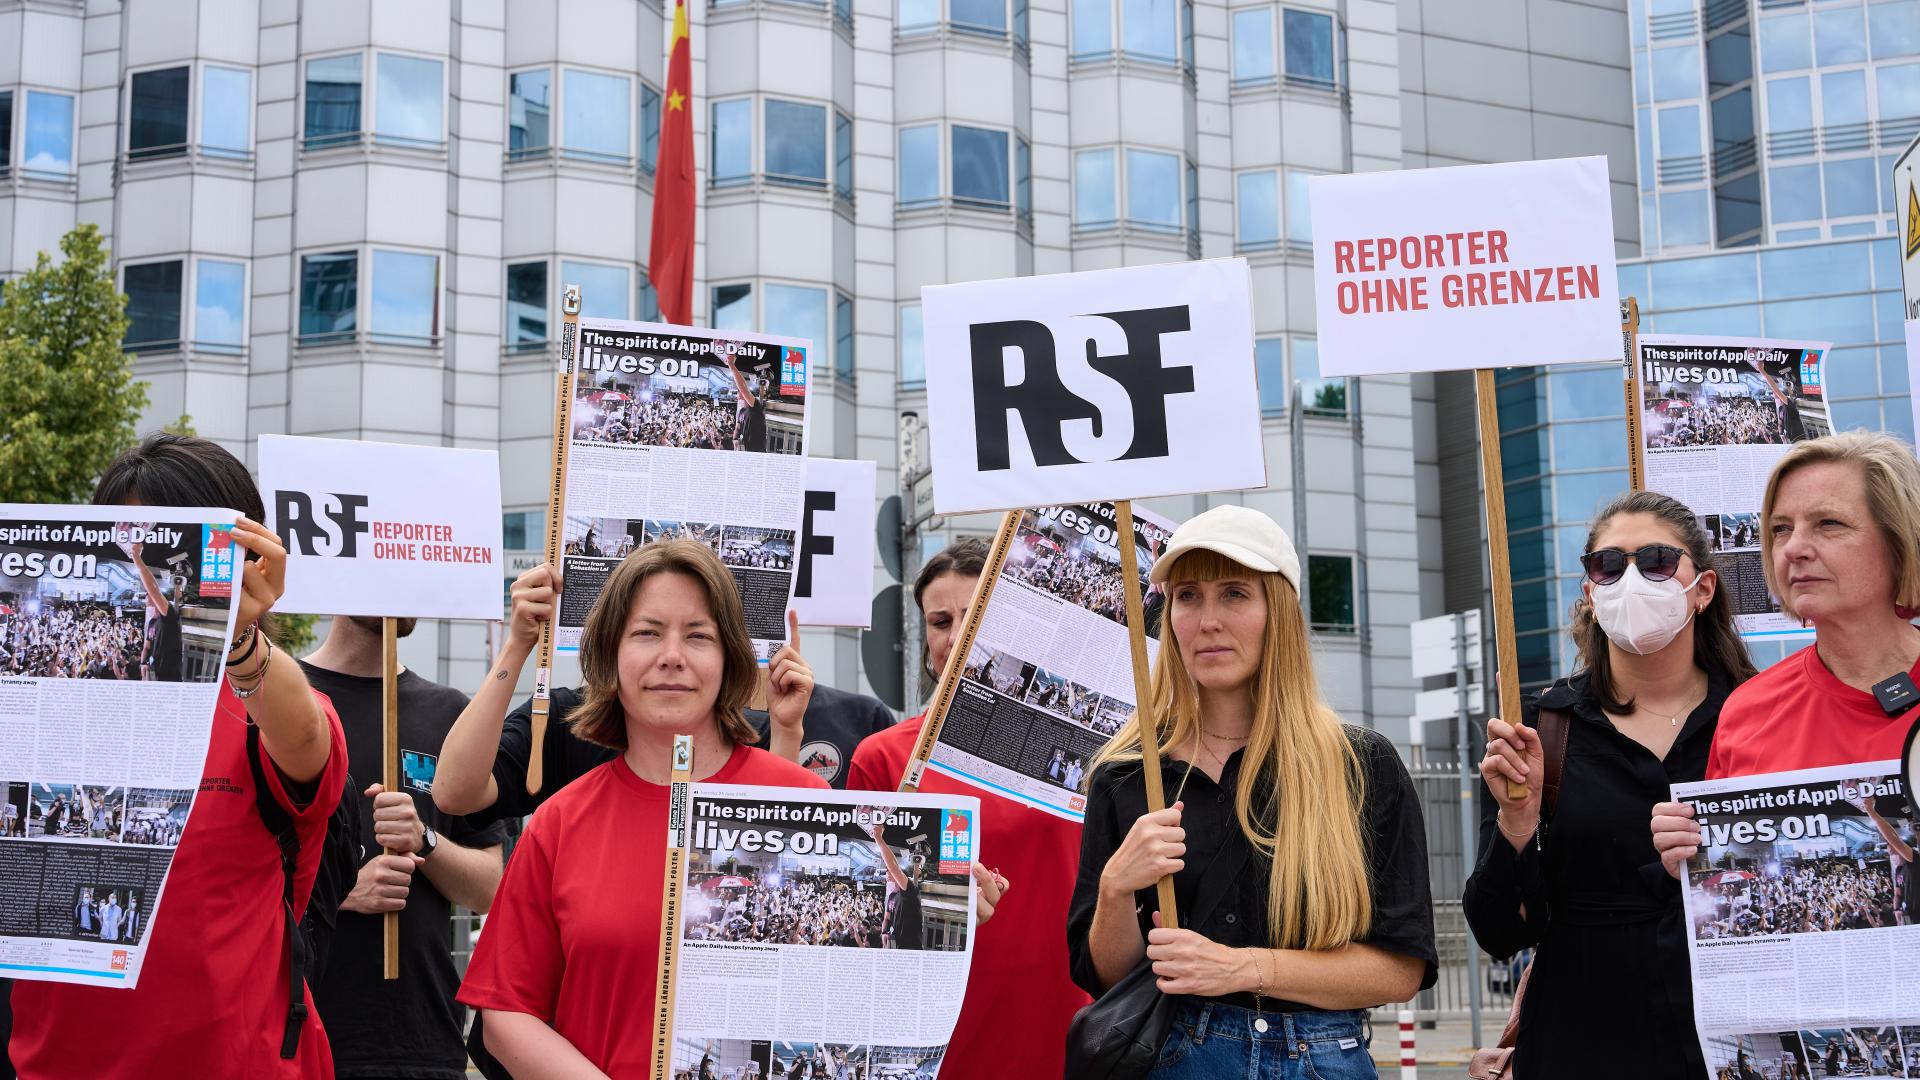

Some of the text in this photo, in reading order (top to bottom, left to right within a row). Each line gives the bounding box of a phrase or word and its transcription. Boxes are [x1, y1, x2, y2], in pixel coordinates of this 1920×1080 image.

[1334, 230, 1509, 273] REPORTER
[1337, 265, 1600, 315] OHNE GRENZEN
[584, 332, 766, 360] The spirit of Apple Daily
[1644, 348, 1789, 365] The spirit of Apple Daily
[582, 347, 699, 378] lives on
[1645, 361, 1739, 383] lives on
[969, 304, 1195, 471] RSF
[0, 525, 182, 548] spirit of Apple Daily
[275, 490, 369, 558] RSF
[373, 521, 452, 542] REPORTER
[50, 552, 97, 579] on
[374, 543, 492, 564] OHNE GRENZEN
[1, 678, 22, 686] tyranny
[1721, 794, 1774, 816] spirit
[1775, 790, 1796, 807] of
[1799, 785, 1858, 810] Apple
[1860, 779, 1904, 798] Dail
[696, 801, 921, 830] The spirit of Apple Daily
[1699, 812, 1831, 848] ives on
[695, 820, 839, 855] lives on
[671, 849, 679, 879] FOLTER.
[664, 901, 675, 966] UNTERDRÜCKUNG
[112, 955, 125, 965] 140
[661, 969, 670, 1005] LÄNDERN
[659, 1007, 667, 1034] VIELEN
[659, 1038, 665, 1046] IN
